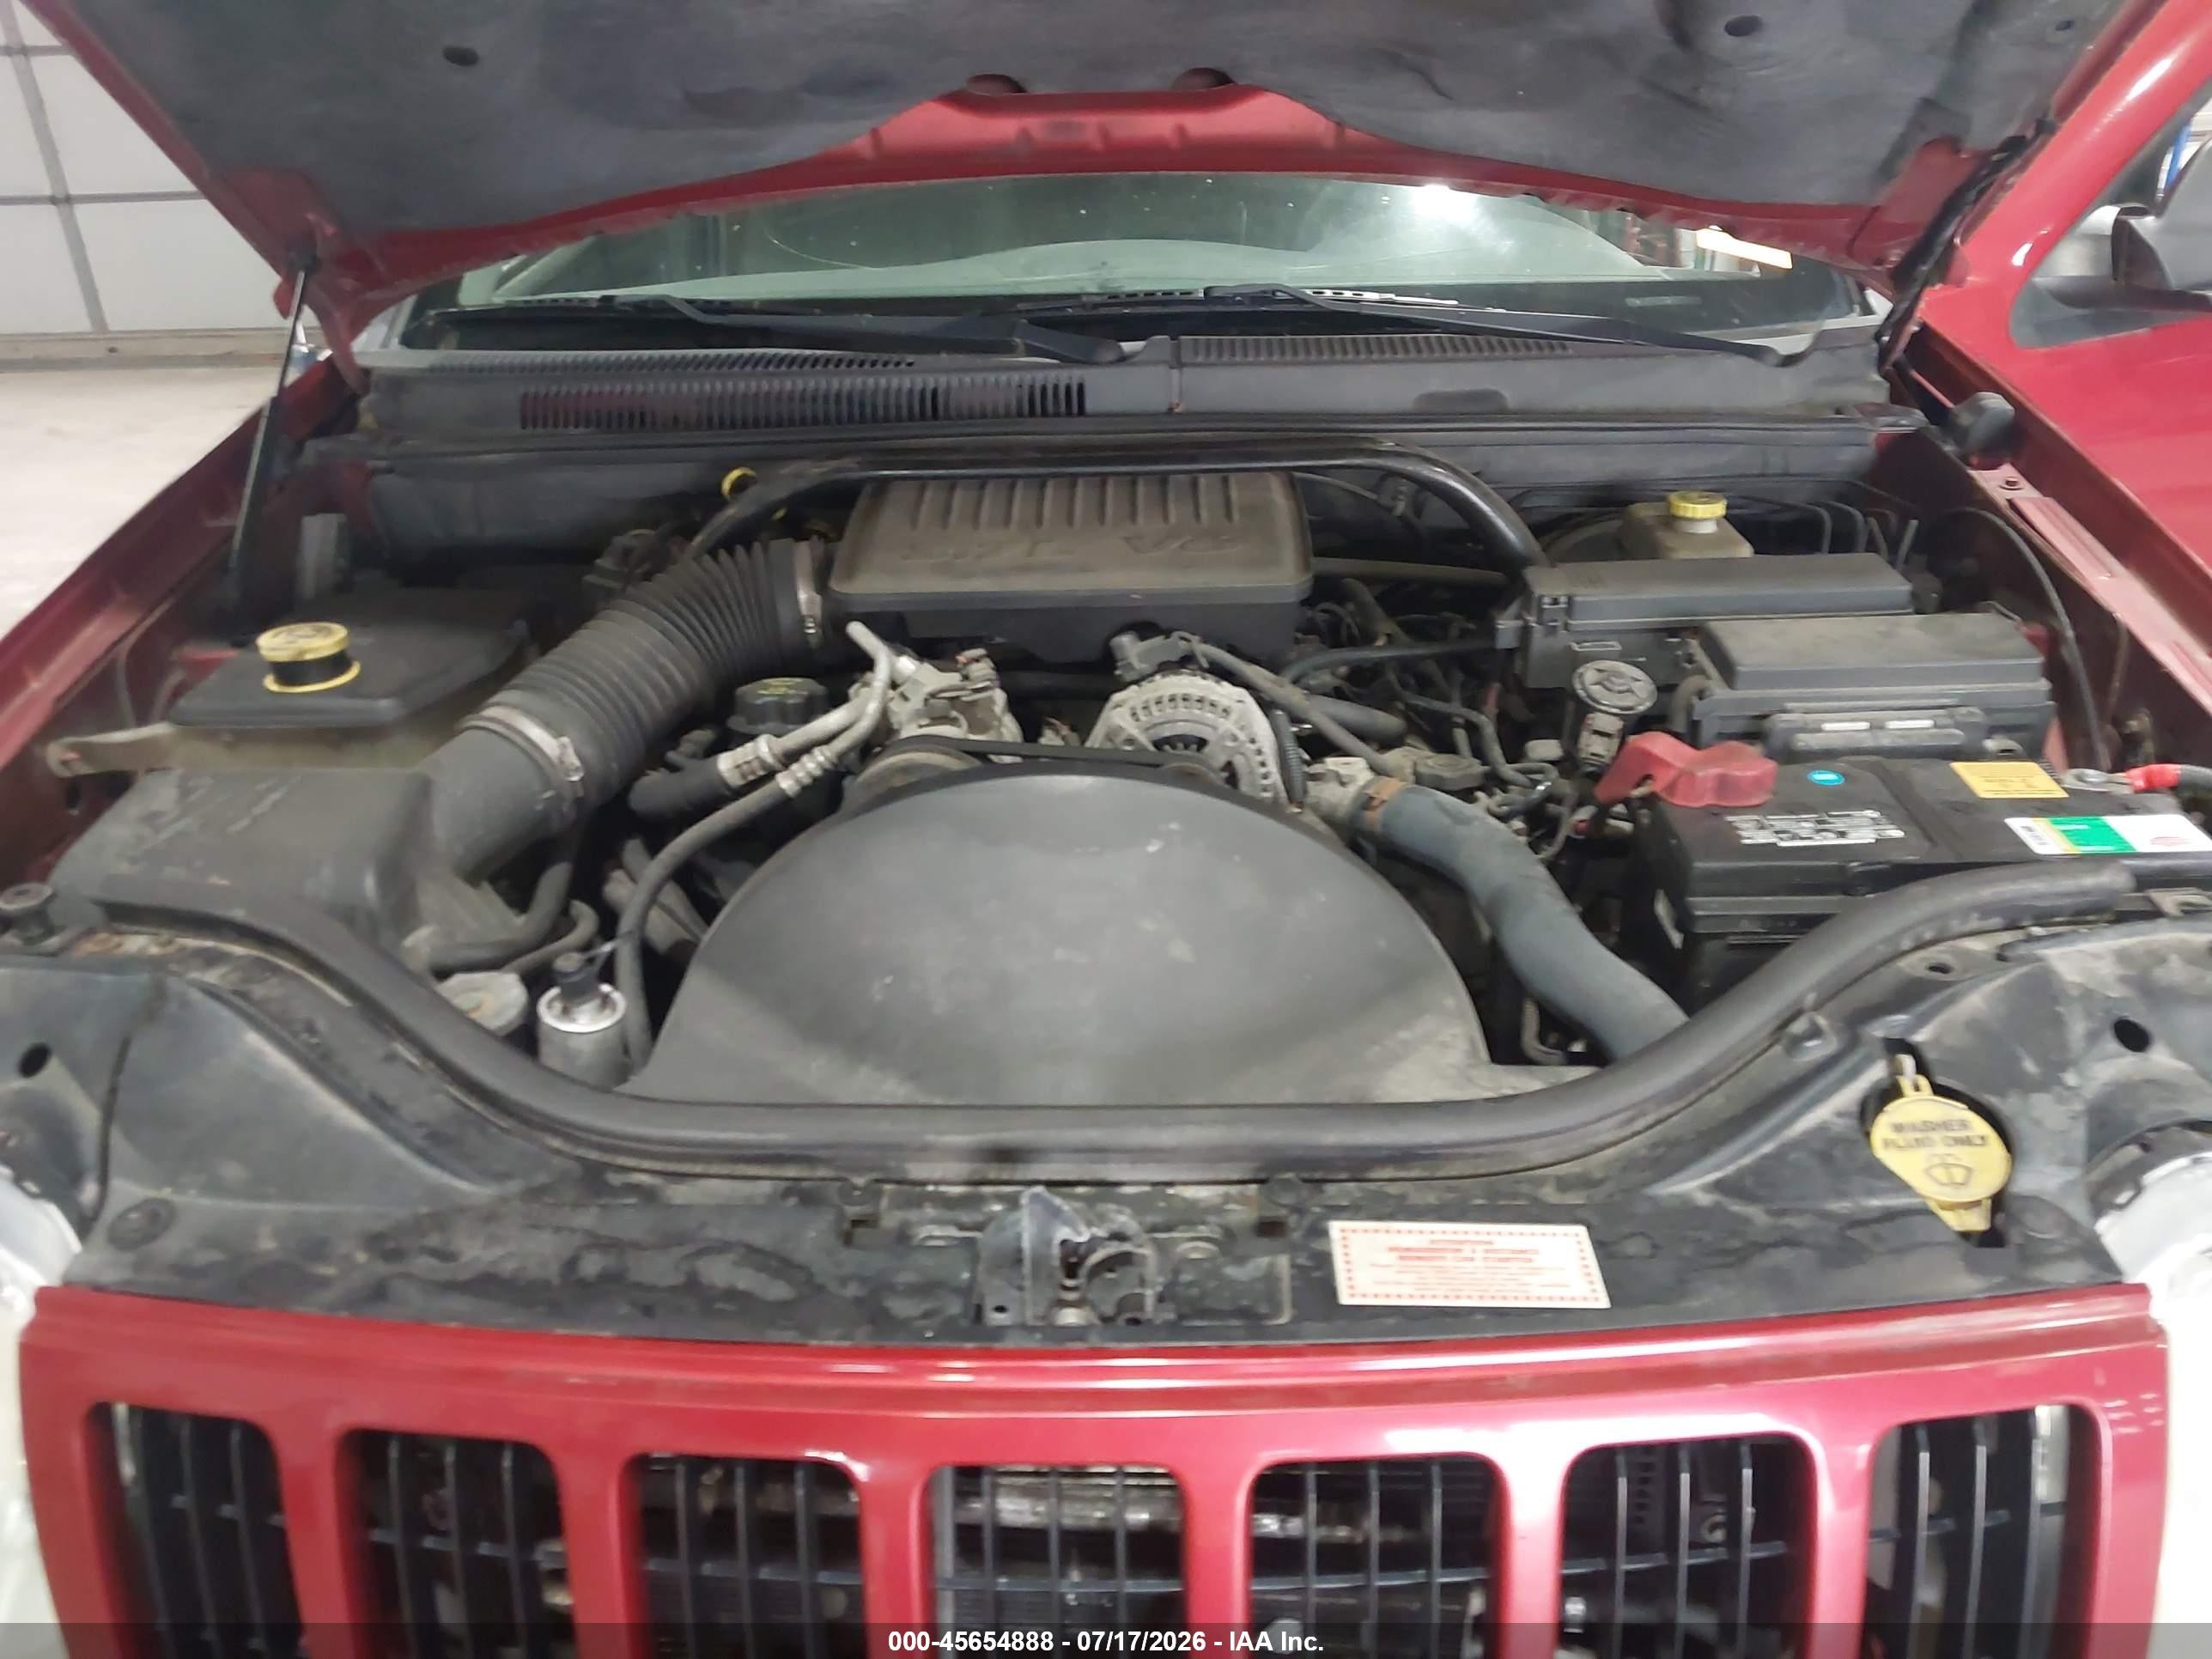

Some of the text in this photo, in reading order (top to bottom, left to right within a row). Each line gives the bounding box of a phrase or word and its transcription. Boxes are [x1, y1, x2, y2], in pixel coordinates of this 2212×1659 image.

[1892, 1119, 1970, 1133] WASHER
[1882, 1134, 1988, 1151] FLUID ONLY
